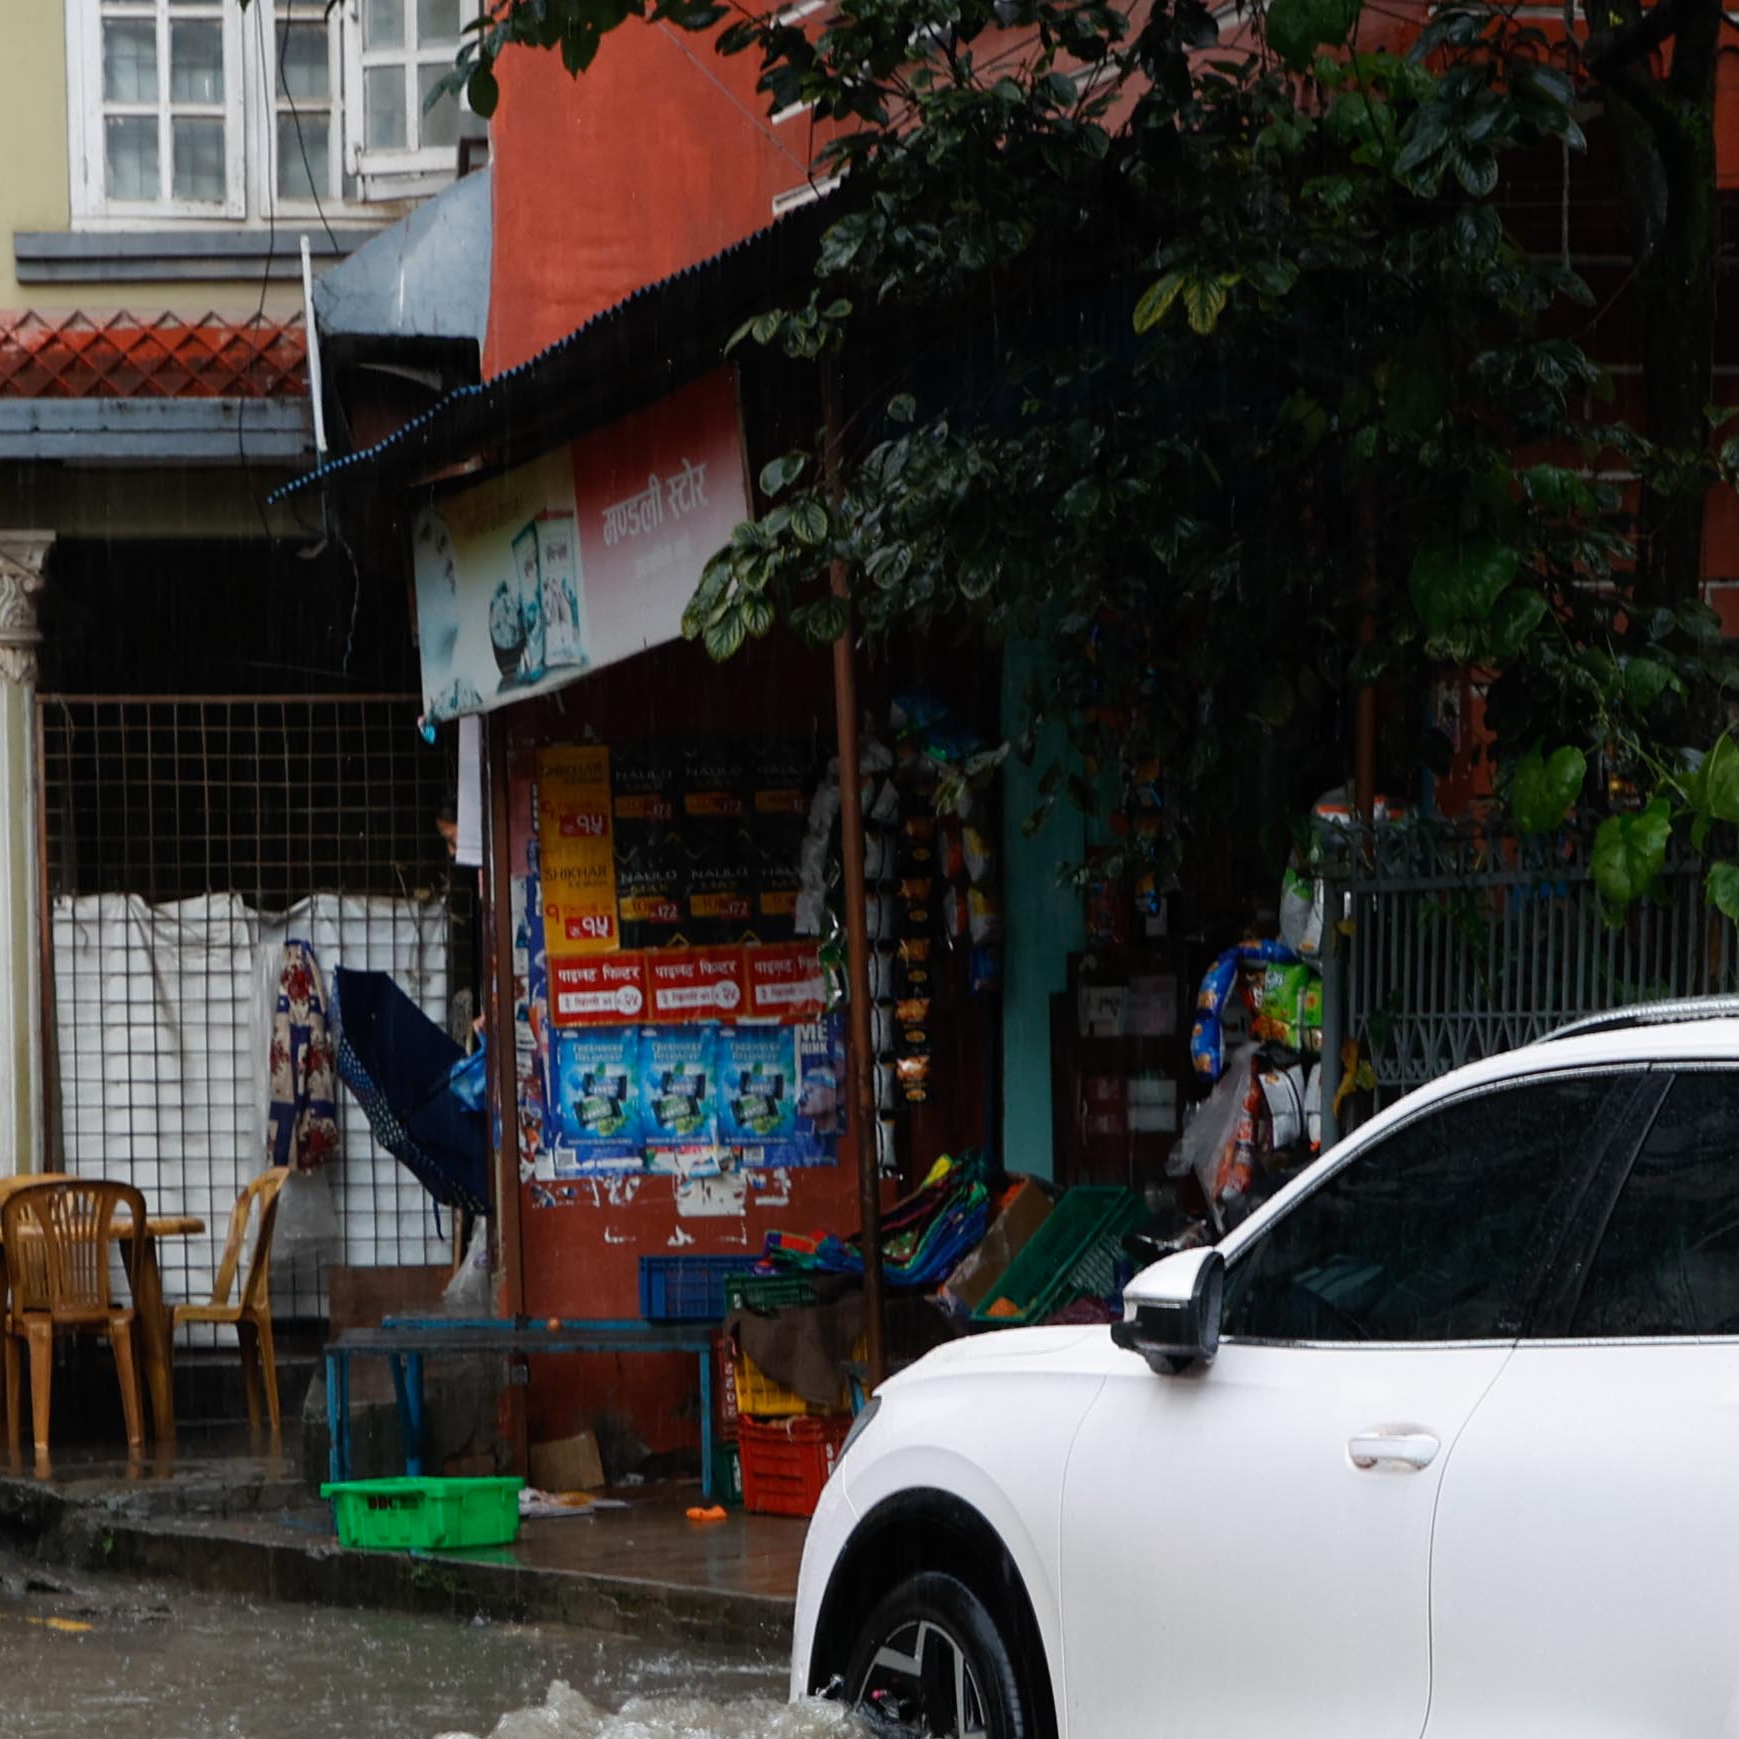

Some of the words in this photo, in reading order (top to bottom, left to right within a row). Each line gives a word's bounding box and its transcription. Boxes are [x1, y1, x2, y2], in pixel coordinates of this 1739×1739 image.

[602, 472, 663, 547] मण्डली
[667, 457, 710, 520] स्टोर
[544, 865, 606, 882] SHIKHAR
[620, 870, 677, 886] NAULO
[581, 916, 610, 938] १५
[801, 1041, 829, 1055] RINK
